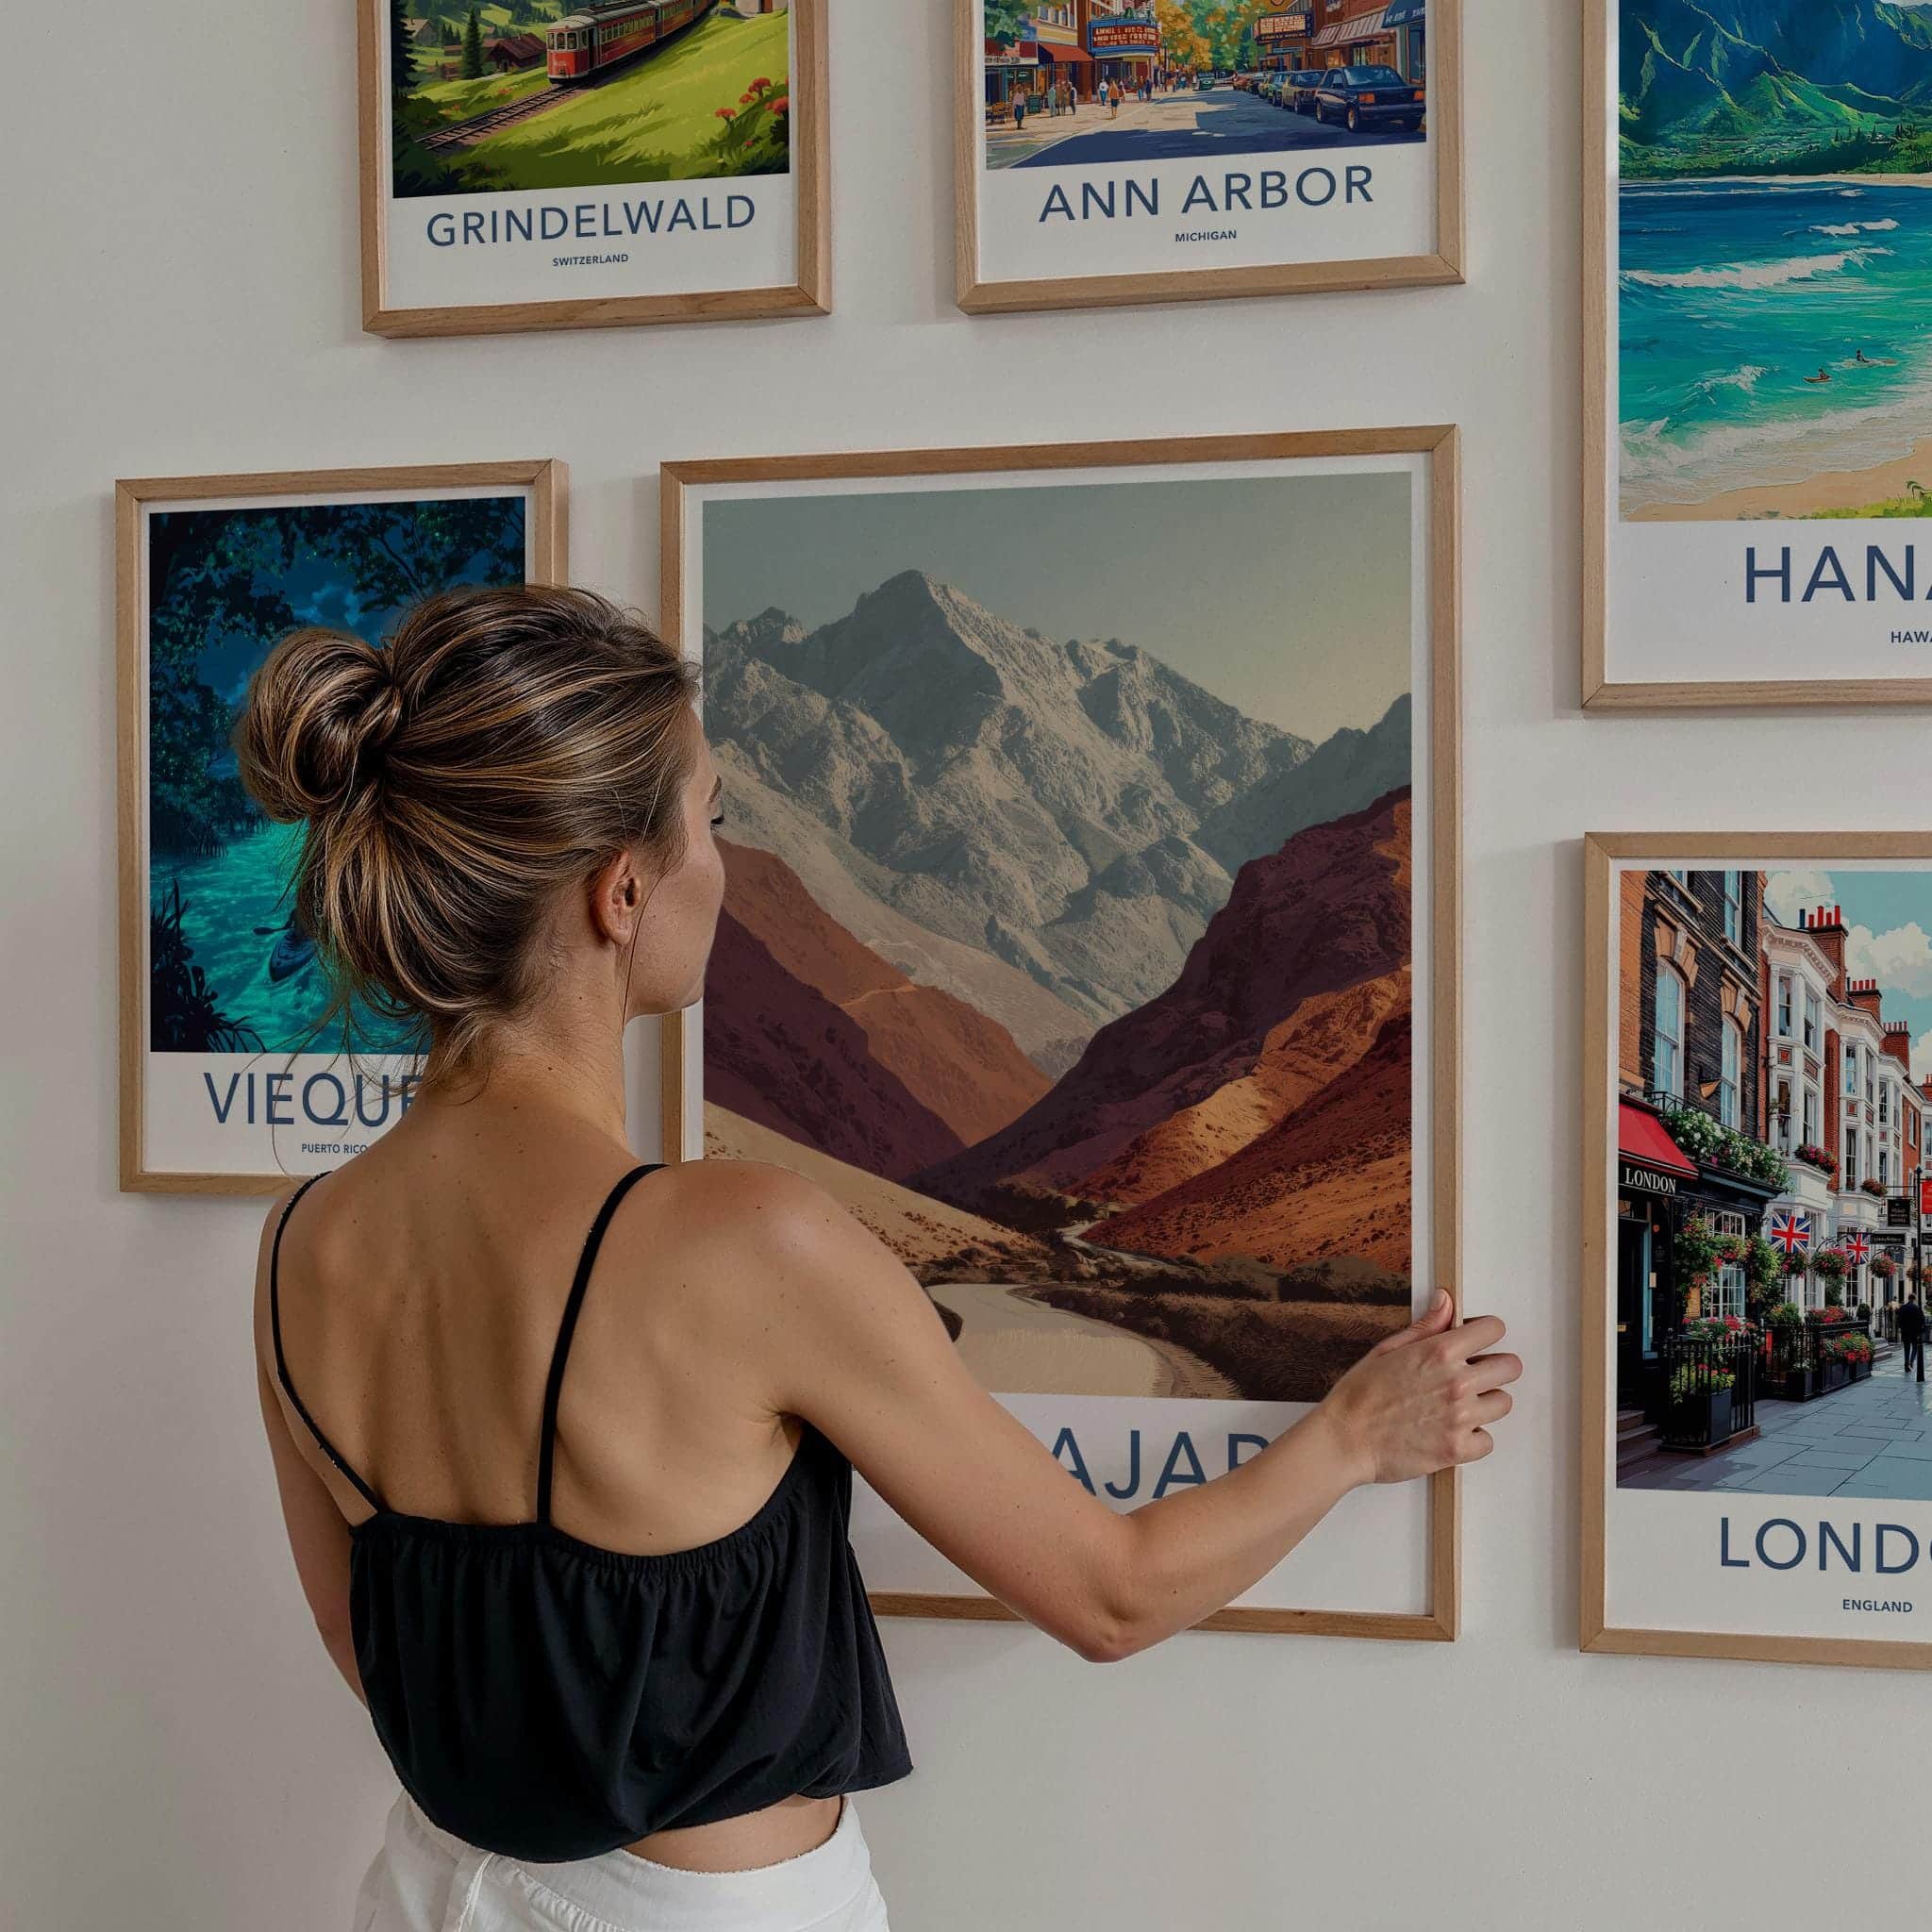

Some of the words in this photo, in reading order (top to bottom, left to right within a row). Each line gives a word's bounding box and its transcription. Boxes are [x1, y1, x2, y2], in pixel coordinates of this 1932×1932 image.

[1039, 177, 1159, 223] ANN
[1181, 165, 1374, 214] ARBOR
[426, 194, 755, 247] GRINDELWALD
[1174, 229, 1237, 242] MICHIGAN
[552, 254, 629, 267] SWITZERLAND
[1745, 544, 1932, 603] HAN
[1890, 630, 1932, 643] HAW
[301, 1143, 341, 1154] PUERTO
[343, 1144, 368, 1154] RICO
[1625, 1167, 1676, 1194] LONDON
[1721, 1516, 1932, 1574] LOND
[1842, 1598, 1913, 1613] ENGLAND
